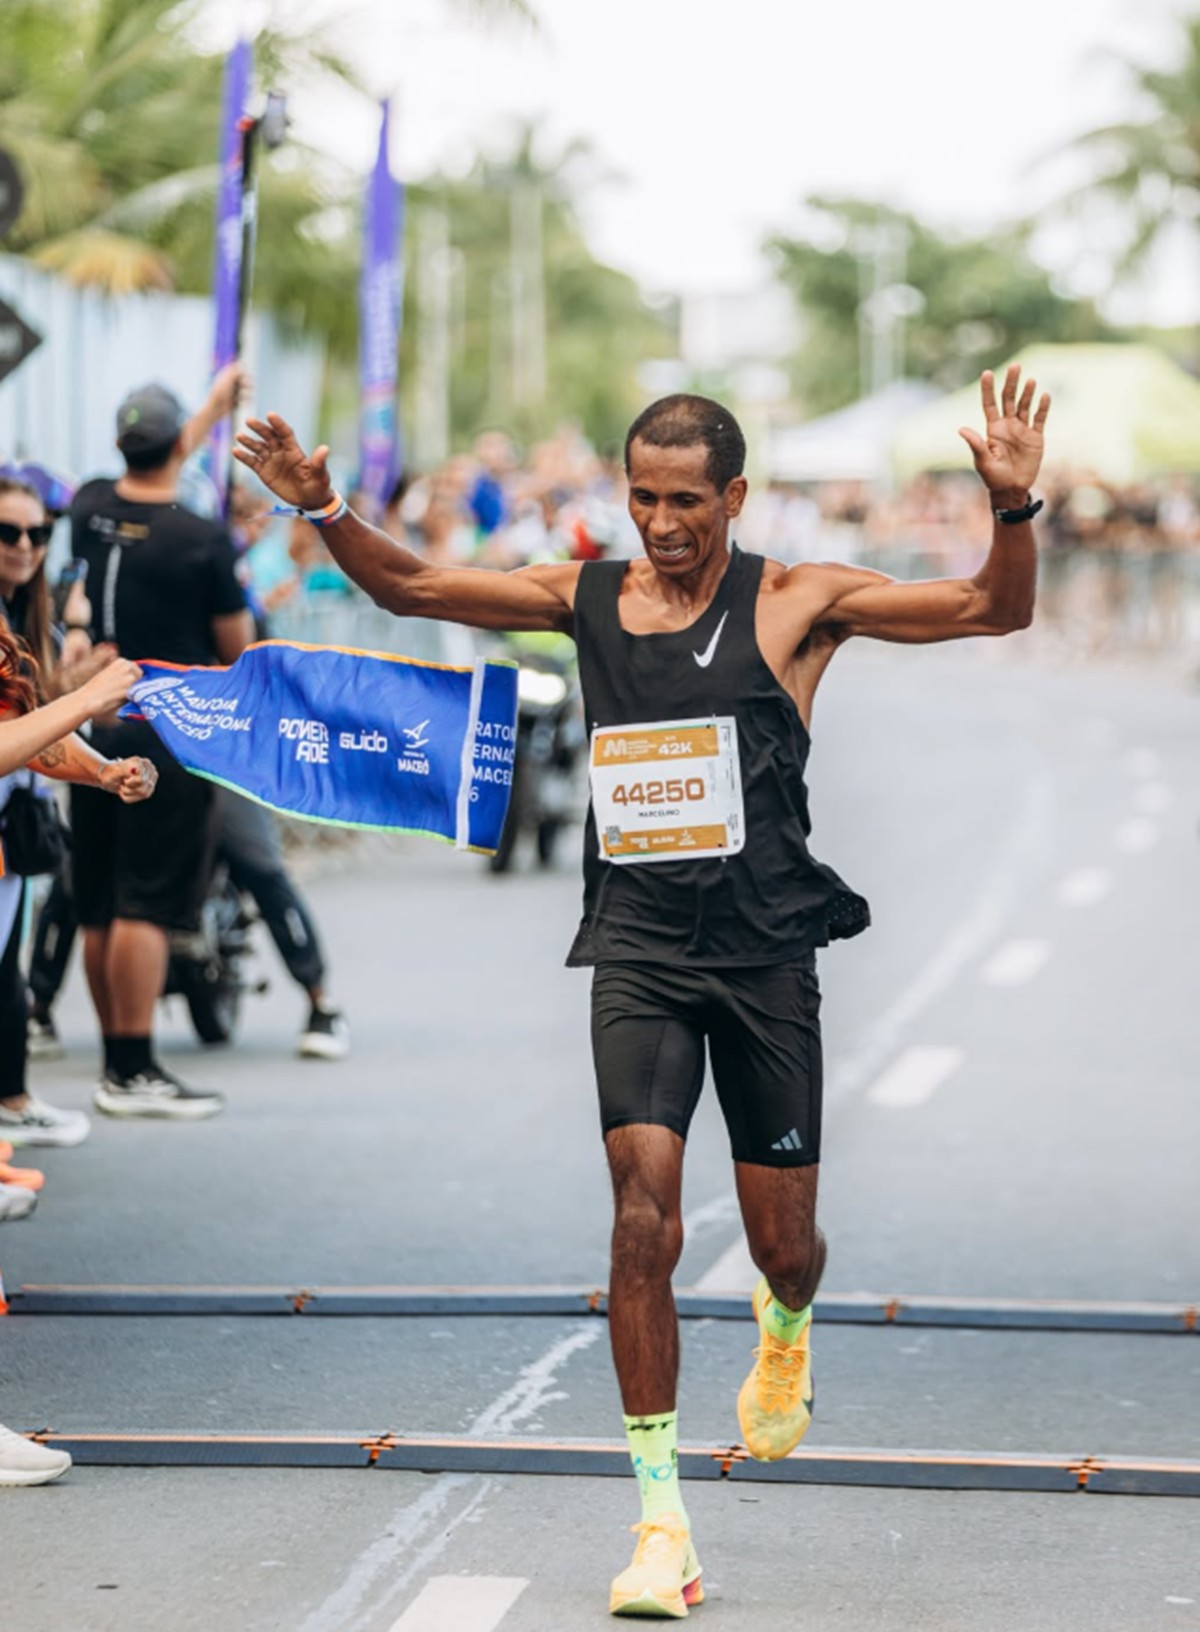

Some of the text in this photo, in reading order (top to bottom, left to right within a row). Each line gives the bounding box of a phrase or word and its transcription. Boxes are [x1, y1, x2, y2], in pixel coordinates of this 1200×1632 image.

[658, 741, 693, 755] 42K
[612, 777, 705, 806] 44250
[638, 808, 680, 818] MARCELINO
